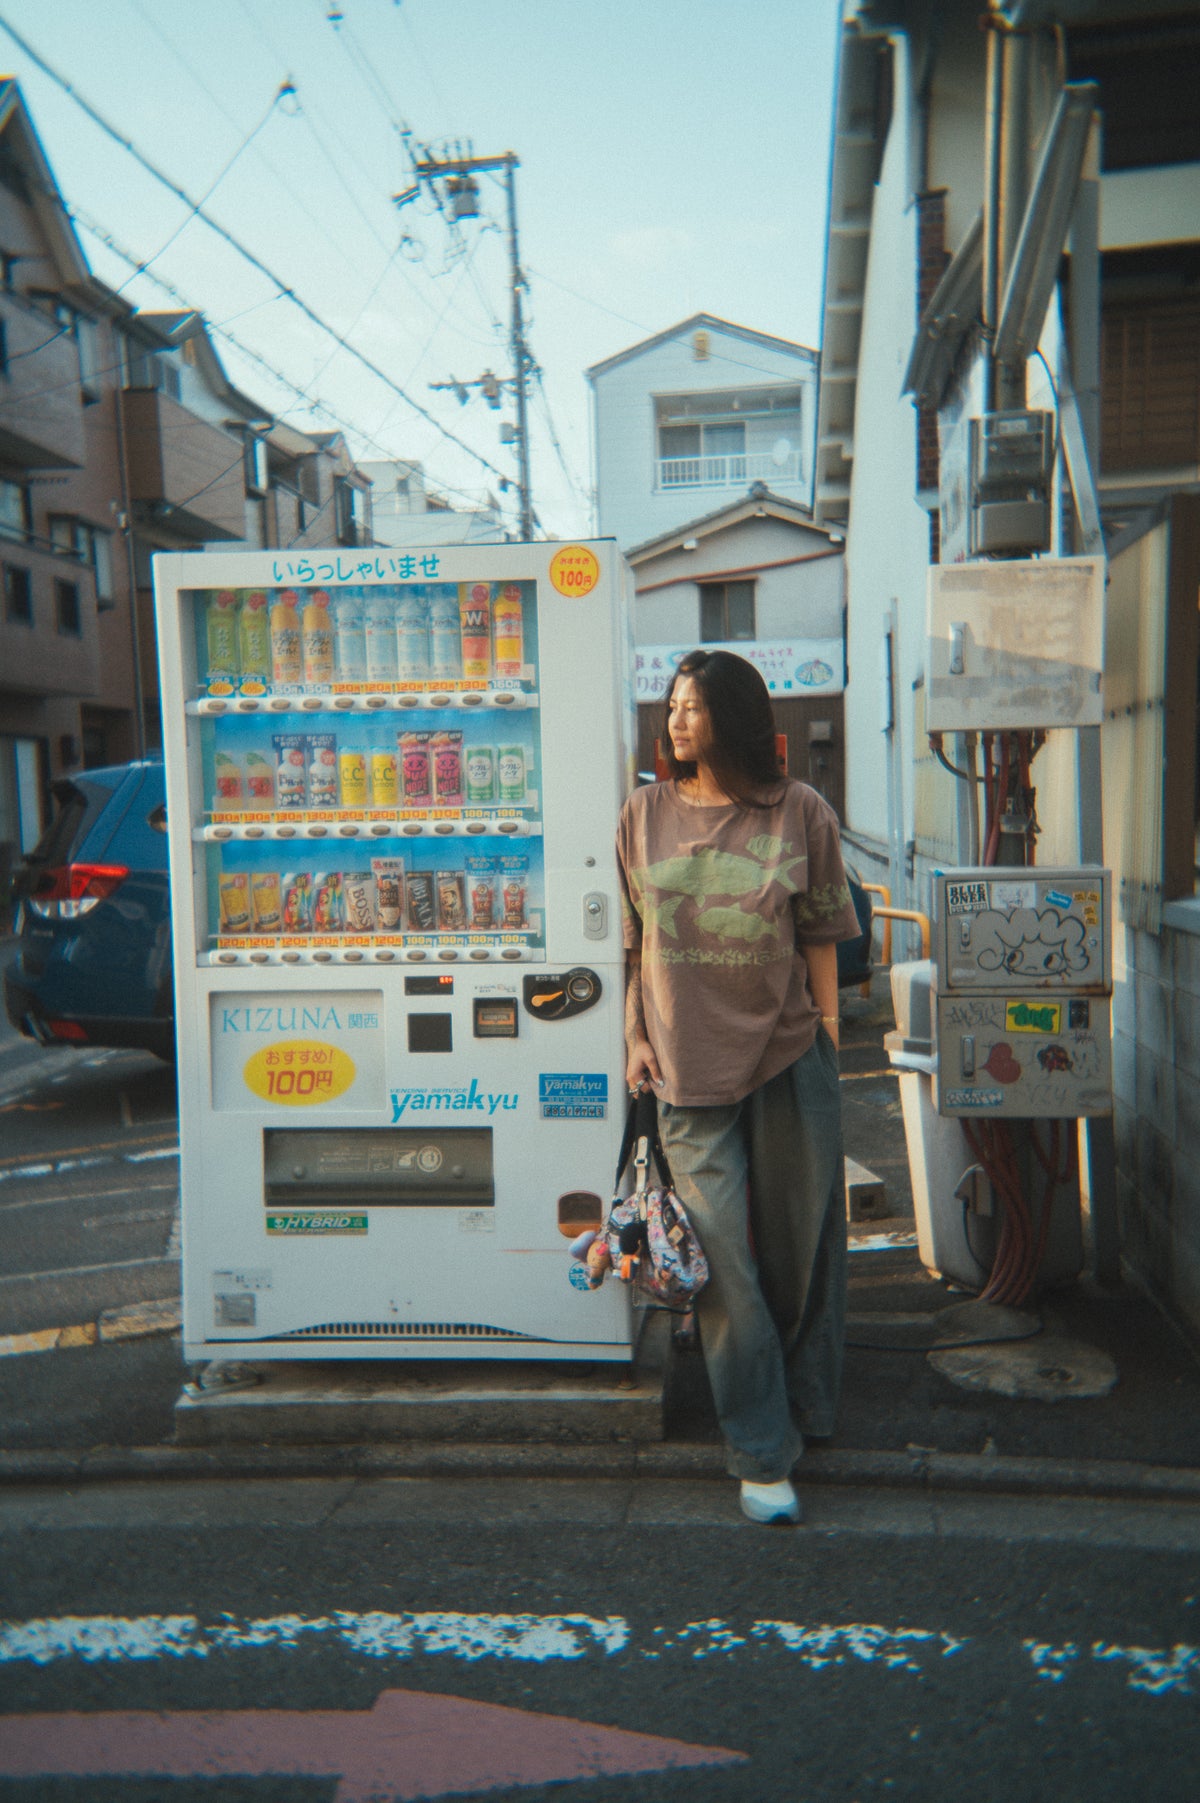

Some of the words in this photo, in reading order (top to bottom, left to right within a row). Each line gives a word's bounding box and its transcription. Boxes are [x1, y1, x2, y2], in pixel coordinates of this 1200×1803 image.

[273, 553, 440, 582] いらっしゃいませ
[560, 570, 592, 587] 100円
[749, 648, 793, 658] オムライス
[406, 780, 429, 794] NOPE
[437, 779, 460, 793] NOPE
[950, 883, 985, 897] BLUE
[352, 887, 373, 929] BOSS
[412, 881, 433, 928] BLACK
[222, 1006, 342, 1033] KIZUNA
[348, 1012, 378, 1029] 関西
[265, 1049, 334, 1065] おすすめ!
[266, 1069, 333, 1096] 100円
[545, 1075, 602, 1096] yamakyu
[389, 1078, 519, 1123] yamakyu
[283, 1217, 352, 1232] HYBRID
